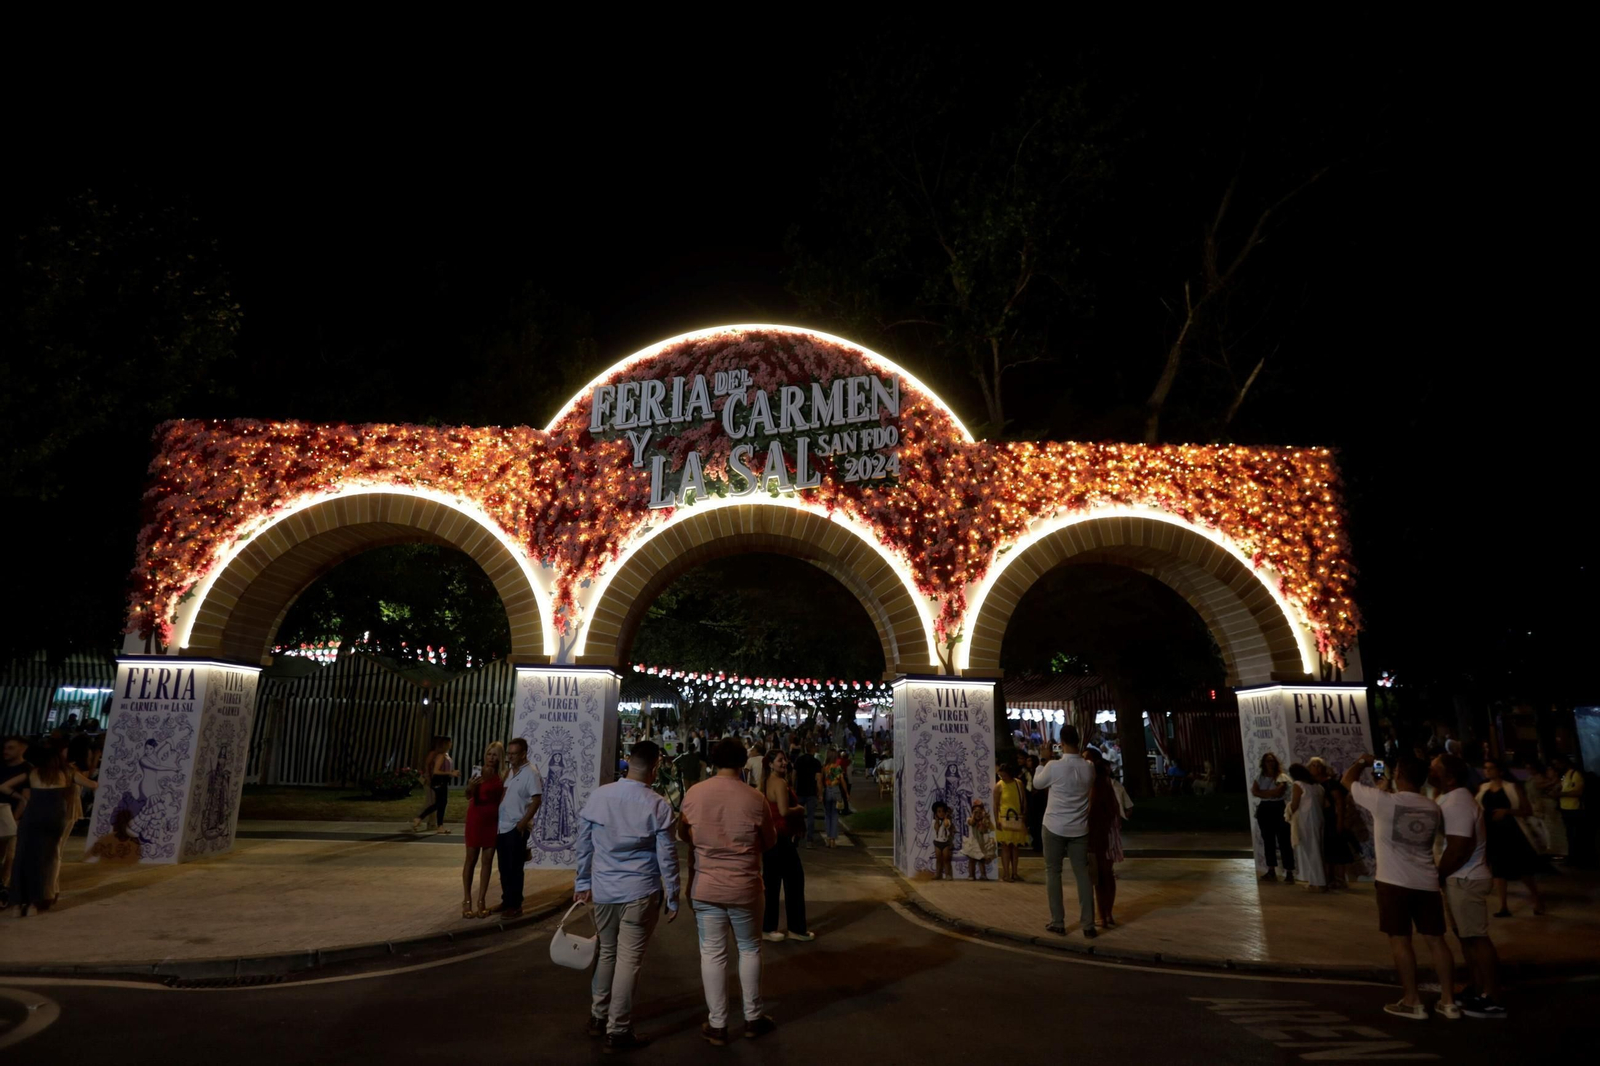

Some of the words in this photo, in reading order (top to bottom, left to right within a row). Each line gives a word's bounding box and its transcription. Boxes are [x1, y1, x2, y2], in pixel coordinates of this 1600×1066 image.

[714, 369, 753, 396] DEL
[589, 374, 716, 433] FERIA
[722, 373, 900, 439] CARMEN
[816, 431, 860, 457] SAN
[861, 425, 899, 451] FDO
[627, 428, 652, 468] Y
[649, 451, 708, 509] LA
[729, 436, 821, 498] SAL
[844, 452, 900, 482] 2024
[123, 667, 196, 700] FERIA
[226, 671, 243, 692] VIVA
[547, 676, 579, 696] VIVA
[130, 702, 158, 711] CARMEN
[171, 702, 180, 712] LA
[181, 702, 194, 712] SAL
[547, 698, 578, 710] VIRGEN
[936, 688, 968, 708] VIVA
[1252, 696, 1270, 715] VIVA
[547, 712, 578, 722] CARMEN
[938, 710, 969, 721] VIRGEN
[1292, 693, 1362, 724] FERIA
[940, 724, 969, 733] CARMEN
[1304, 725, 1330, 735] CARMEN
[1342, 726, 1350, 735] LA
[1351, 726, 1363, 736] SAL
